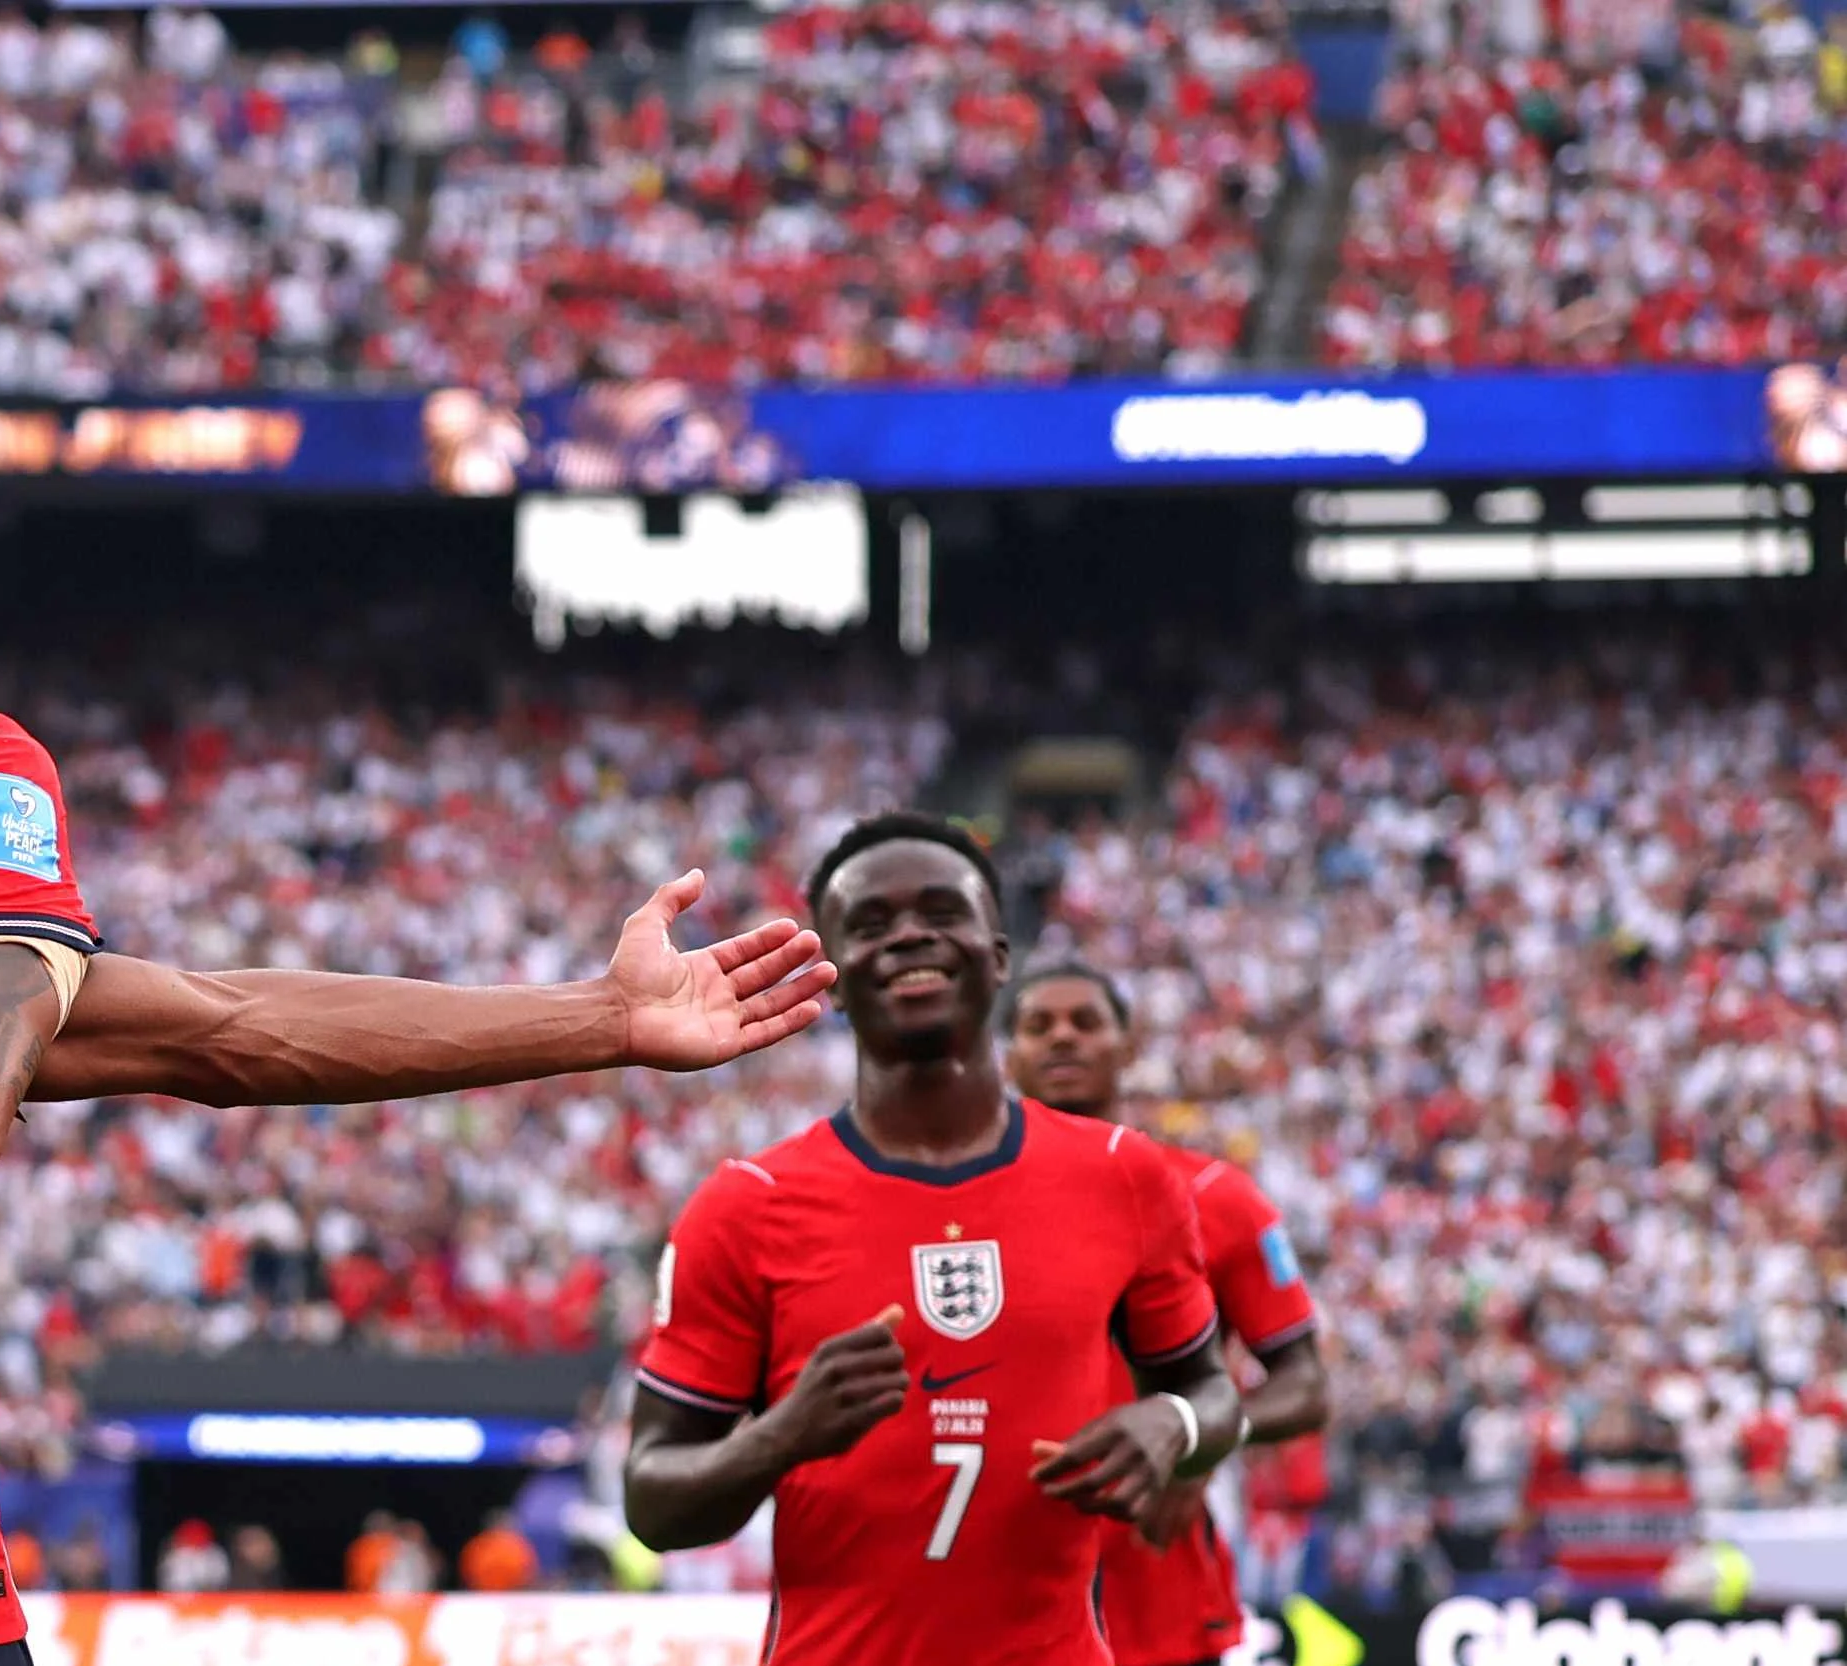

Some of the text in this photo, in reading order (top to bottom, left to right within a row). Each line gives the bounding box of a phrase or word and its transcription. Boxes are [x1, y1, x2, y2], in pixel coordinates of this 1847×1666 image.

[5, 830, 44, 856] PEACE
[12, 850, 35, 864] FIFA
[924, 1442, 985, 1560] 7
